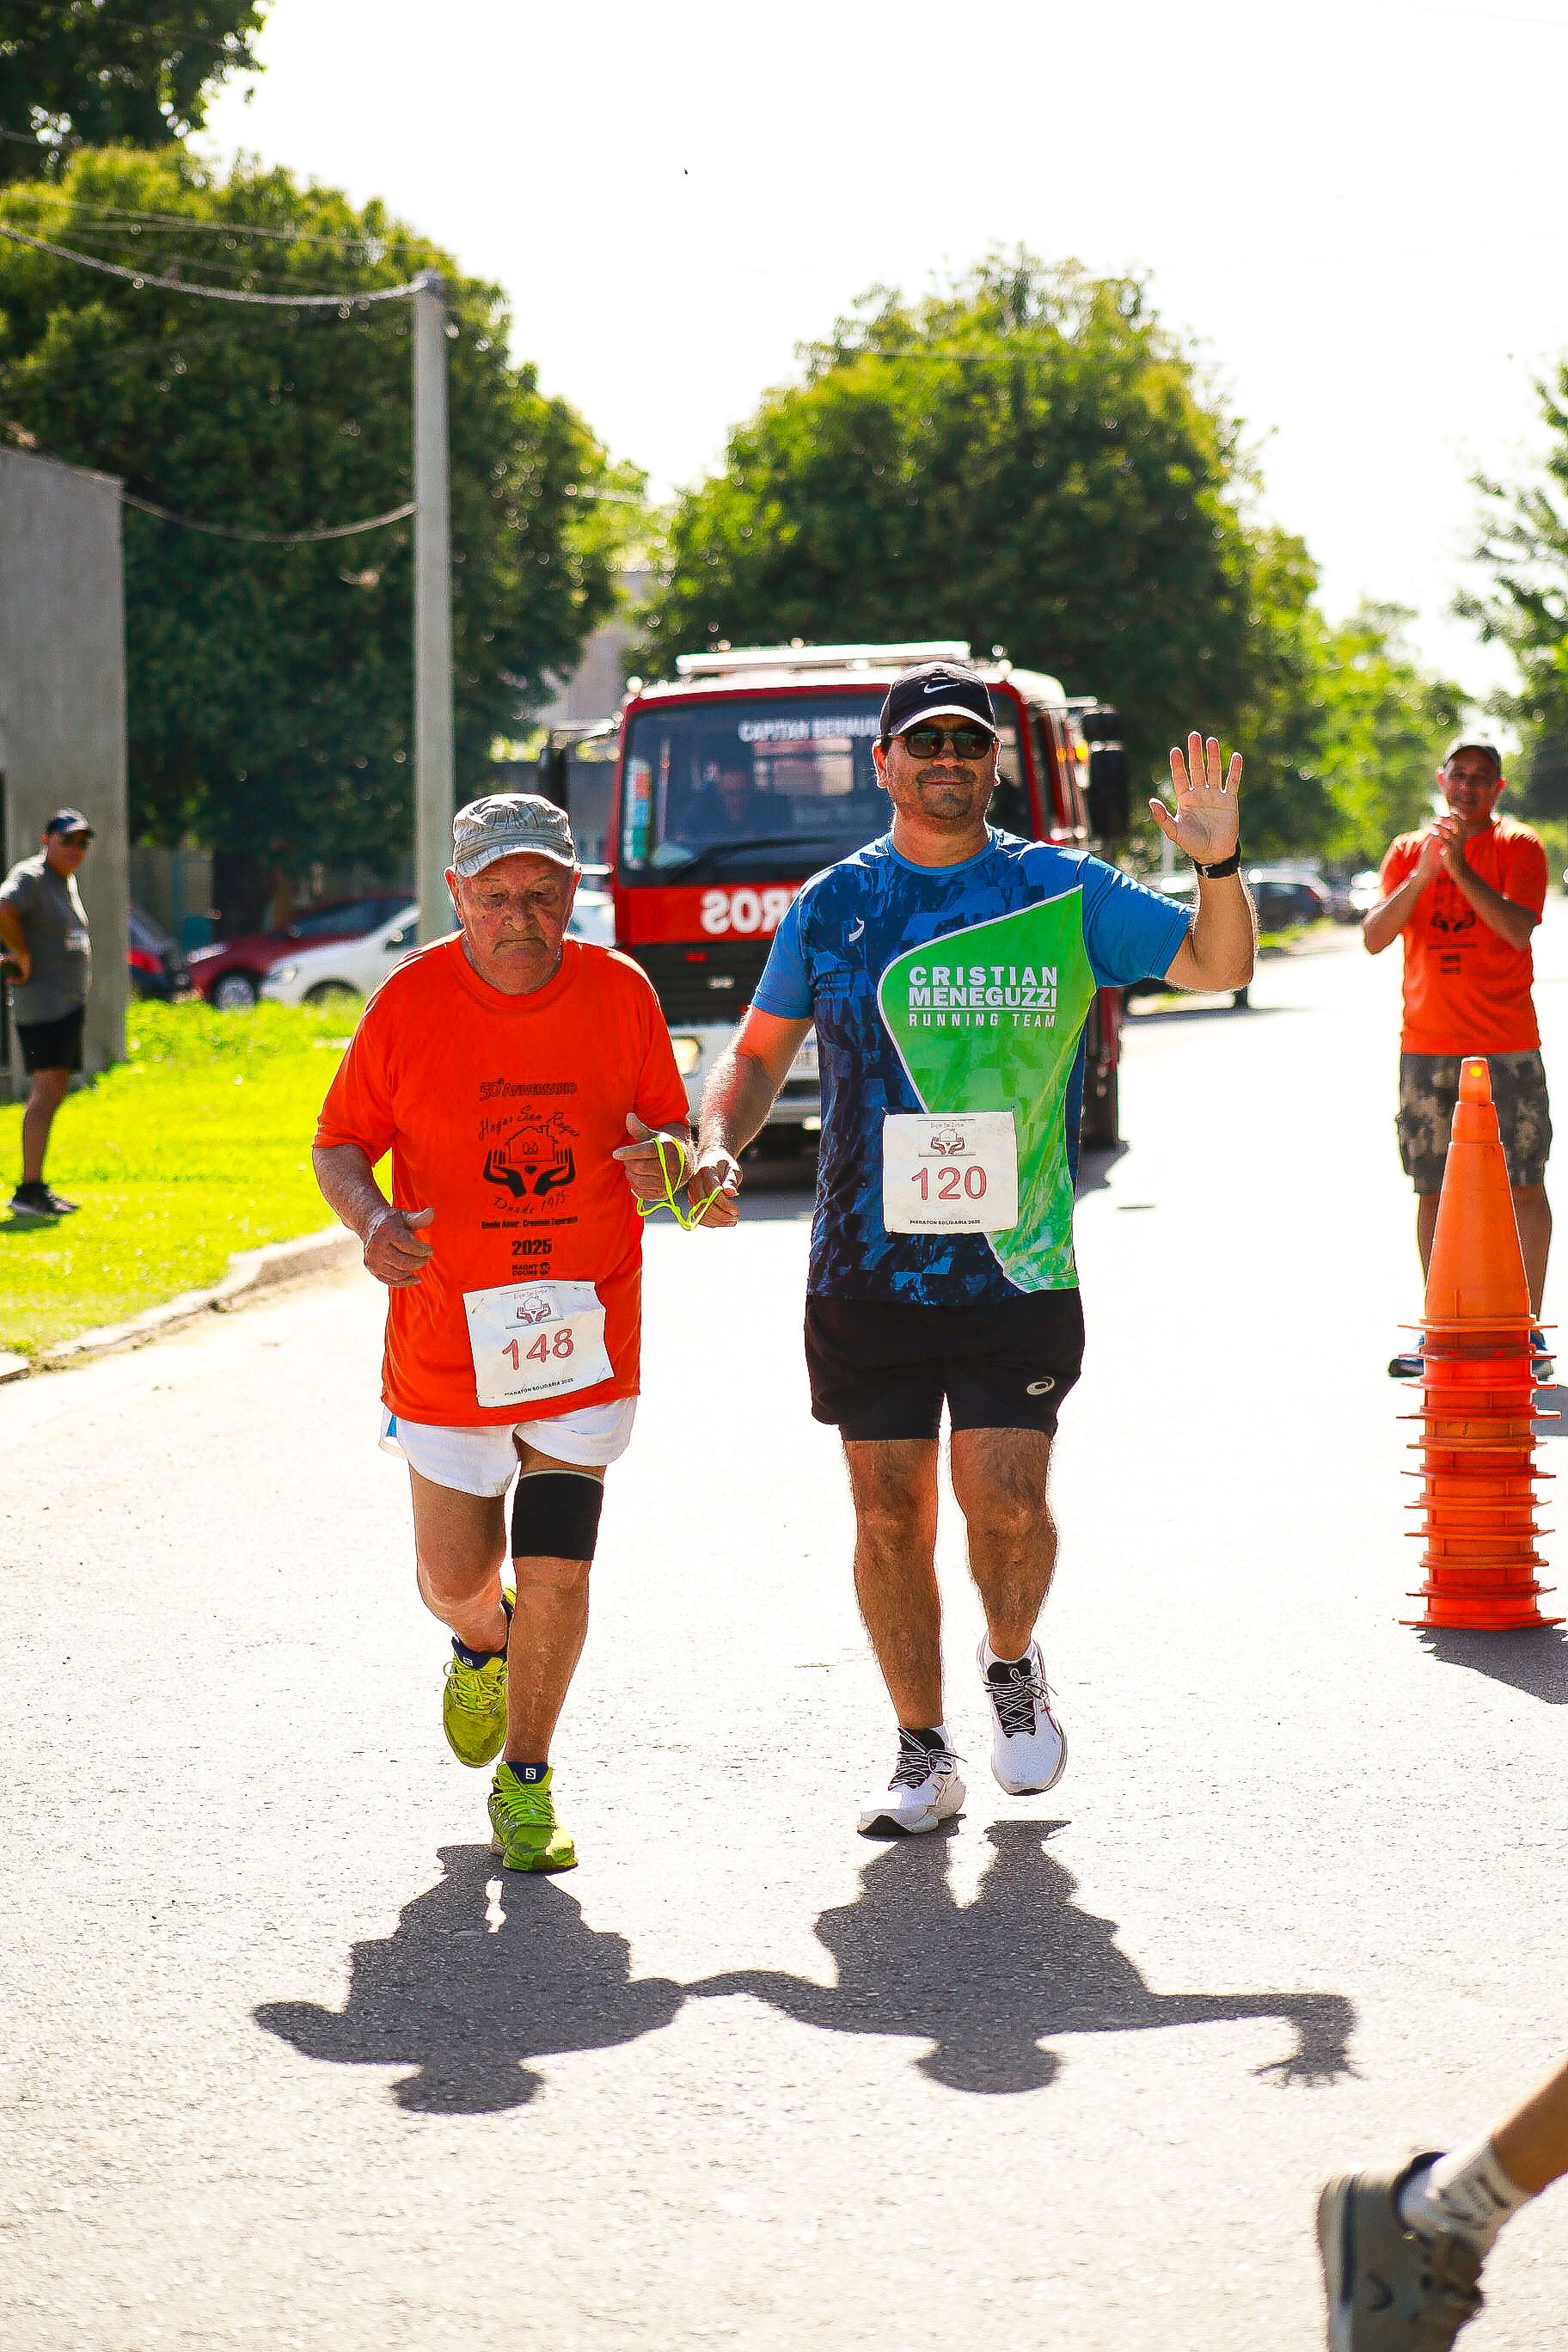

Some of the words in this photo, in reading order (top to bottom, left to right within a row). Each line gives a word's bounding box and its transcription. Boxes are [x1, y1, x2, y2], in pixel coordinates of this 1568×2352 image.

[909, 966, 1057, 986] CRISTIAN
[909, 987, 1057, 1007] MENEGUZZI
[909, 1013, 999, 1027] RUNNING
[1012, 1014, 1056, 1027] TEAM
[502, 1082, 579, 1098] ANIVERSARIO
[479, 1117, 513, 1142] Hogar
[517, 1106, 543, 1122] San
[911, 1166, 987, 1201] 120
[511, 1238, 553, 1256] 2025
[502, 1328, 573, 1370] 148
[504, 1387, 532, 1396] MARATON
[532, 1381, 560, 1392] SOLIDARIA
